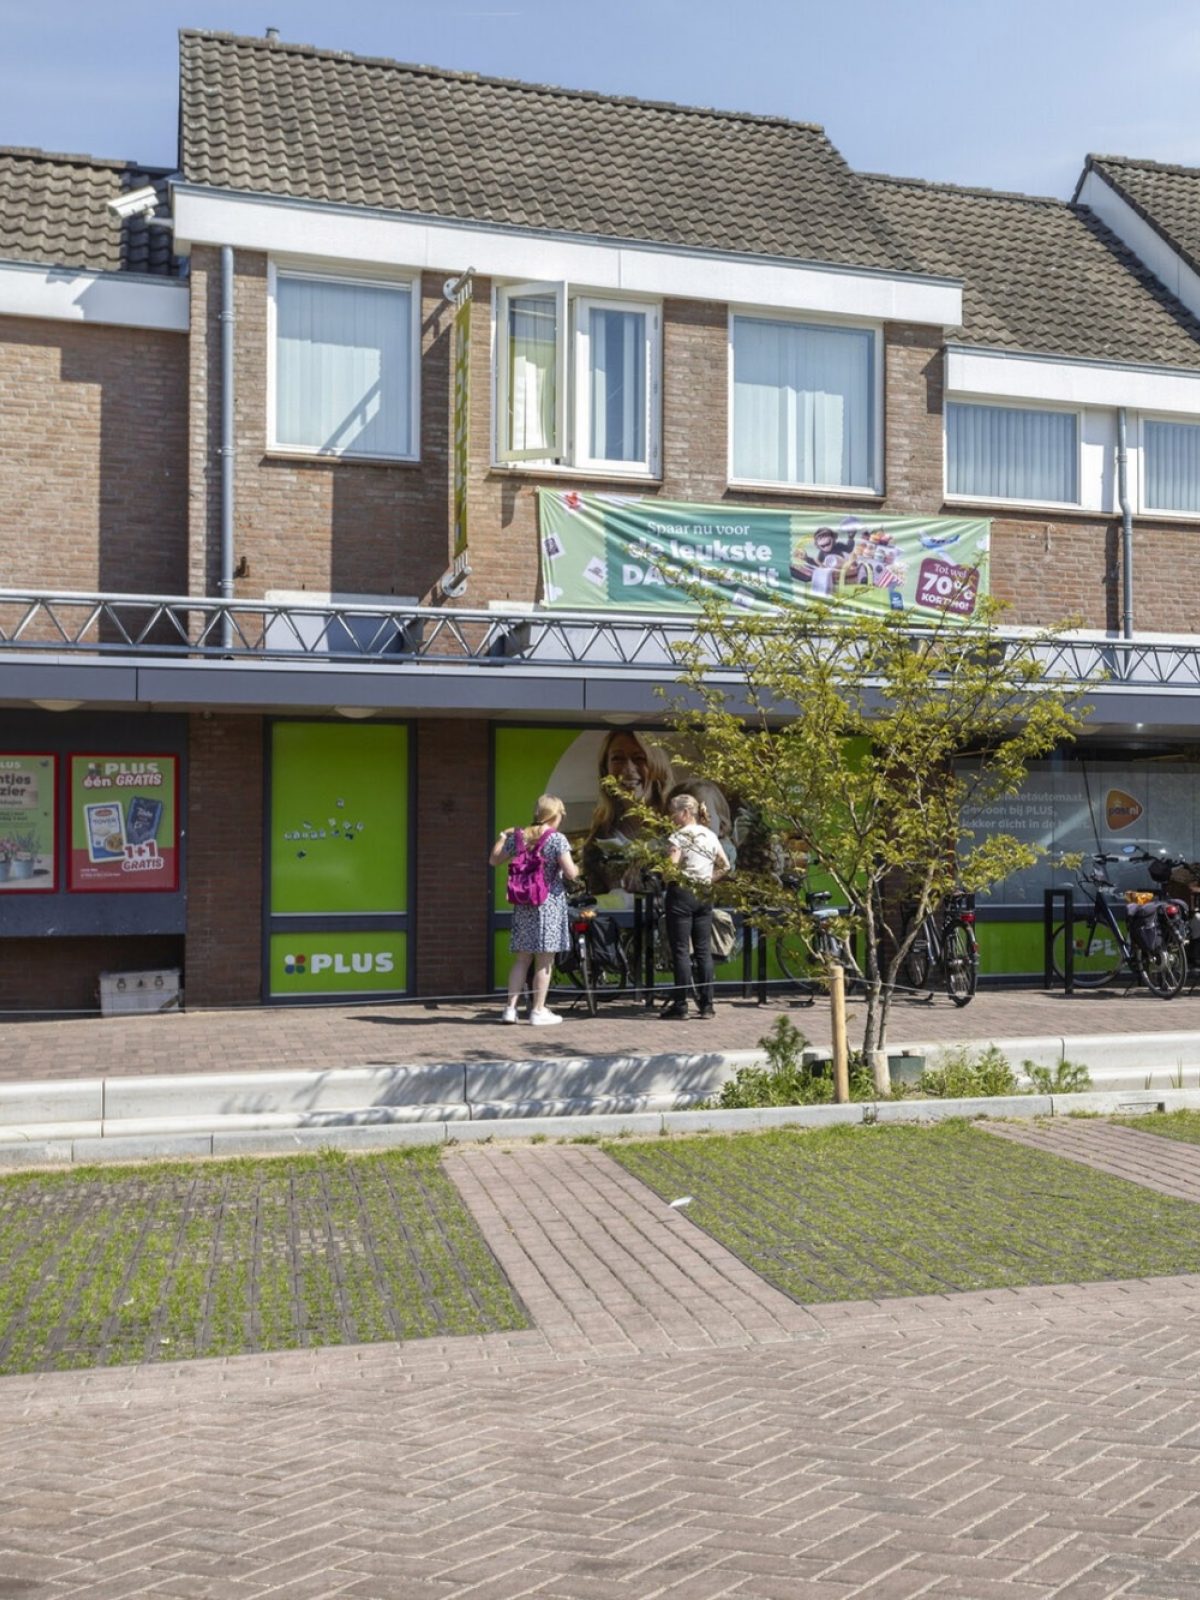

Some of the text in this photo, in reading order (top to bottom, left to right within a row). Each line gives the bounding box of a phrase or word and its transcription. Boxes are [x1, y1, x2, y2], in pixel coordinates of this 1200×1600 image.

[648, 521, 750, 536] Spaar nu voor
[670, 539, 773, 562] leukste
[933, 563, 949, 575] Tot
[922, 572, 974, 601] 70%
[105, 762, 159, 775] PLUS
[83, 773, 162, 787] één GRATIS
[1009, 804, 1023, 817] bij
[998, 817, 1026, 829] dicht
[1028, 818, 1040, 829] in
[124, 841, 157, 859] 1+1
[123, 859, 162, 870] GRATIS
[310, 952, 394, 974] PLUS
